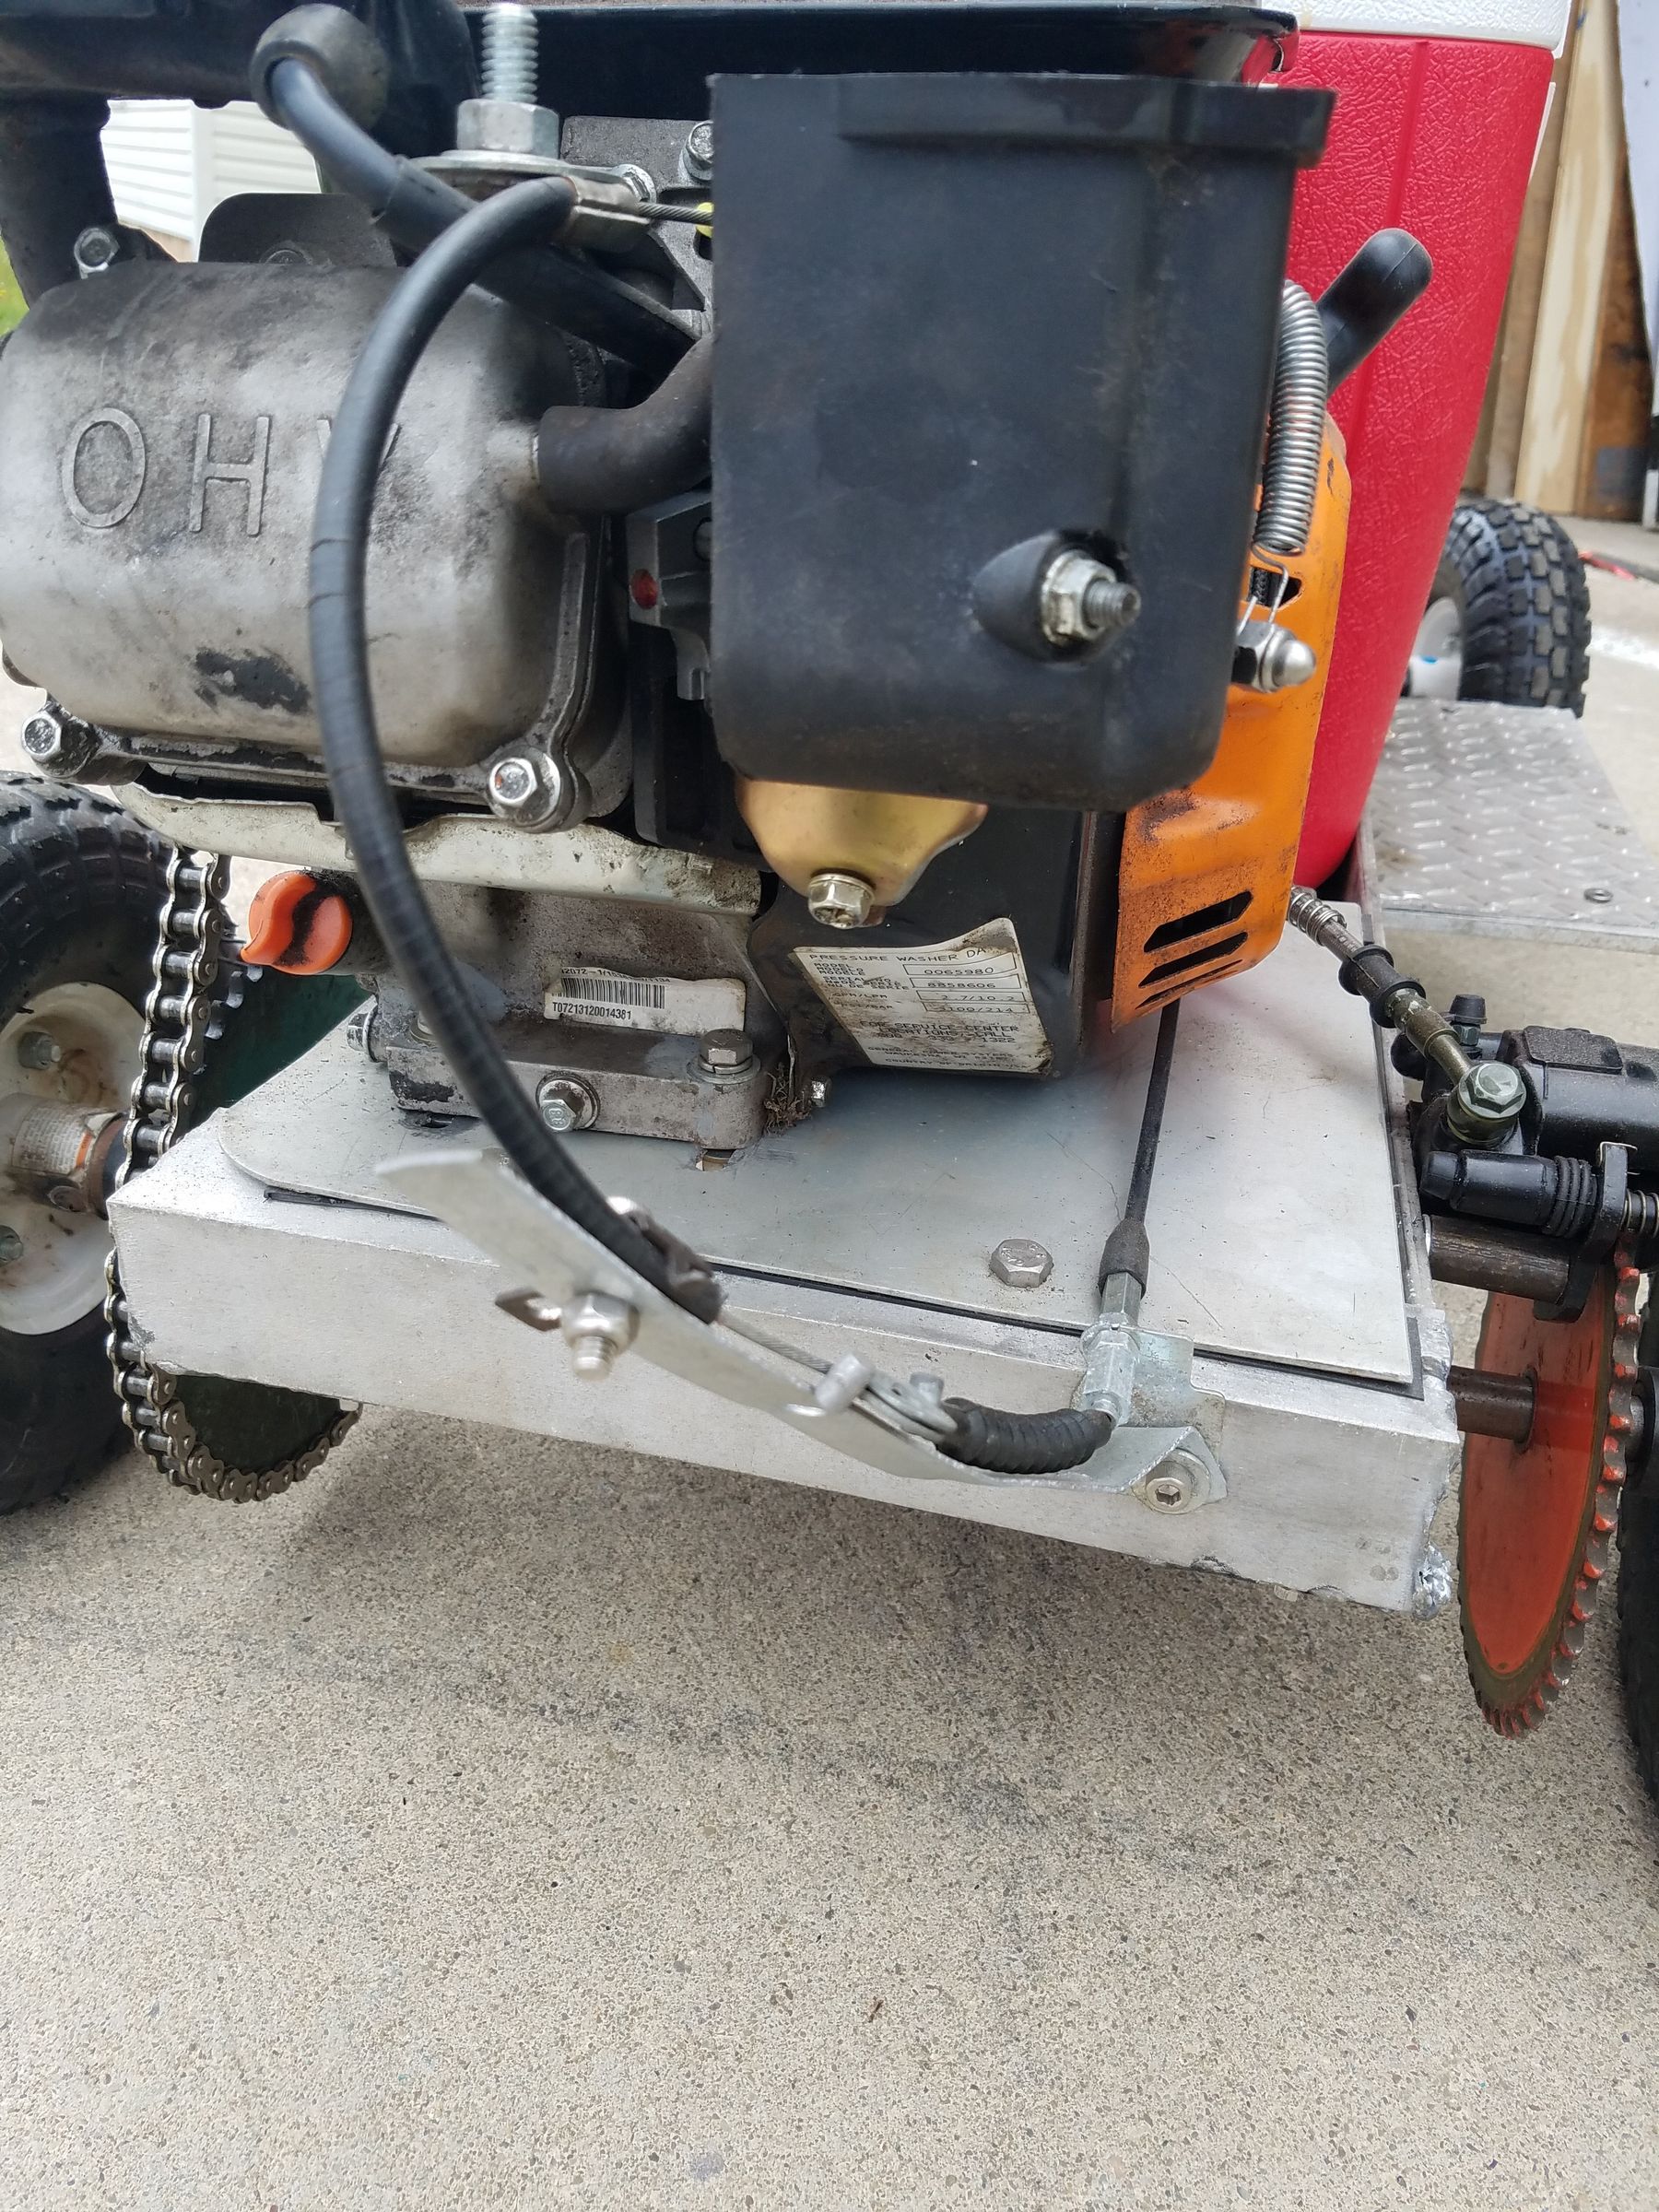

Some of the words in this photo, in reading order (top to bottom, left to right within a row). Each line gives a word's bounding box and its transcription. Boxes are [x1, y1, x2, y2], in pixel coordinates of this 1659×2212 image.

[61, 406, 401, 537] OH
[896, 954, 959, 962] WASHER
[924, 967, 994, 975] 0065980
[894, 1022, 956, 1030] SERVICE
